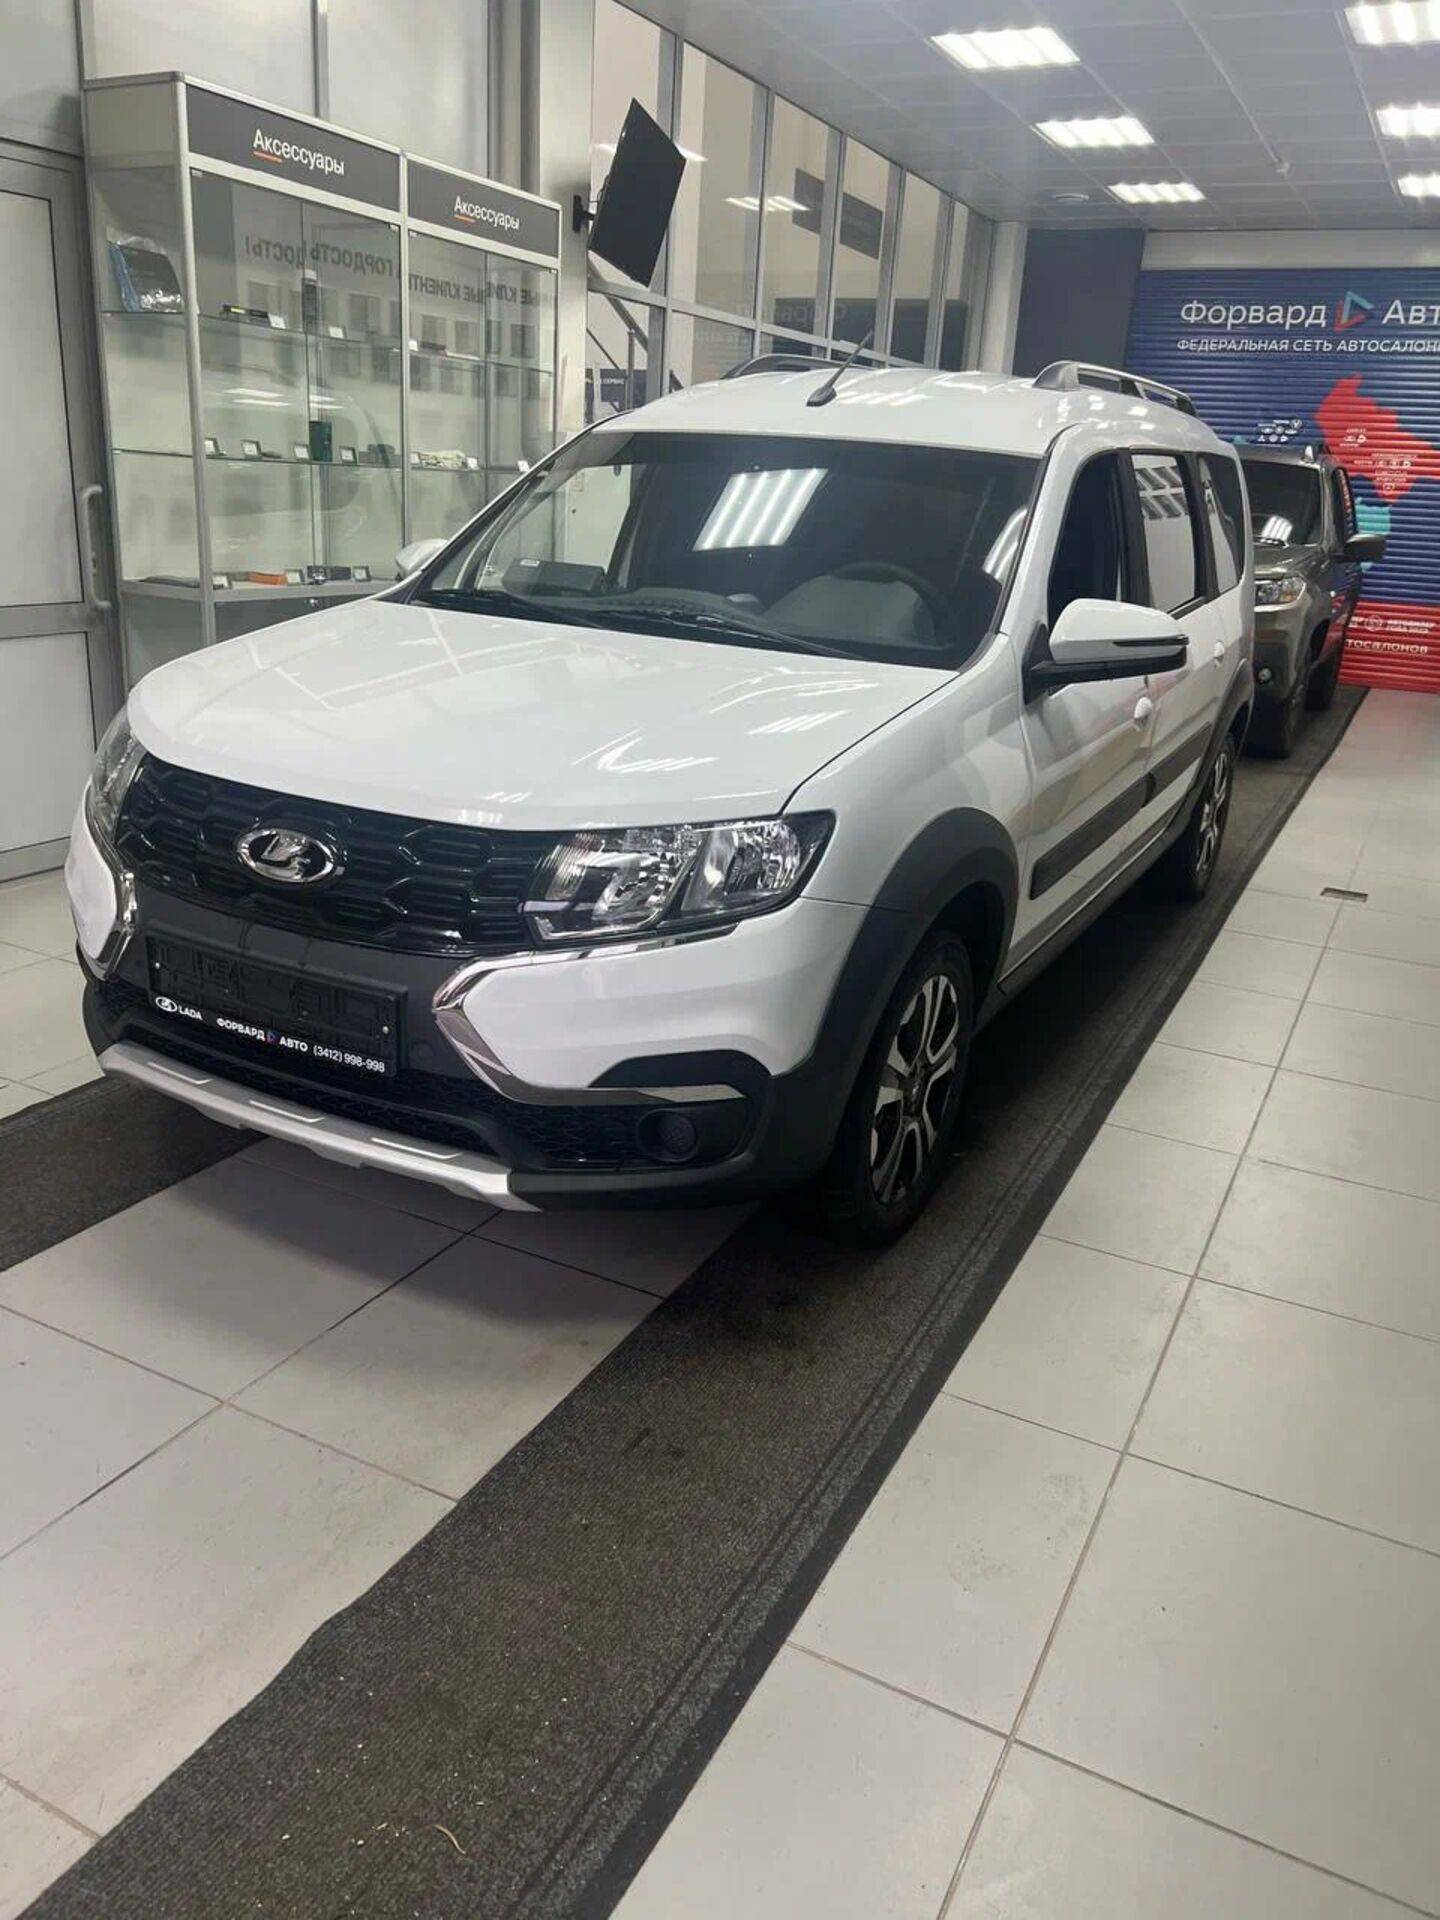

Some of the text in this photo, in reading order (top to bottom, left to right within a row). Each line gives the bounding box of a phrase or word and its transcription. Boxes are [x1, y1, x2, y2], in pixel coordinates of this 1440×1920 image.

[253, 128, 345, 176] Аксессуары
[454, 195, 520, 231] Аксессуары
[1180, 300, 1327, 330] Форвард
[1177, 339, 1440, 352] ФЕДЕРАЛЬНАЯ СЕТЬ АВТОСАЛОН
[178, 1005, 203, 1021] LADA
[216, 1017, 385, 1073] ФОРВАРД АВТО (3412) 998-998
